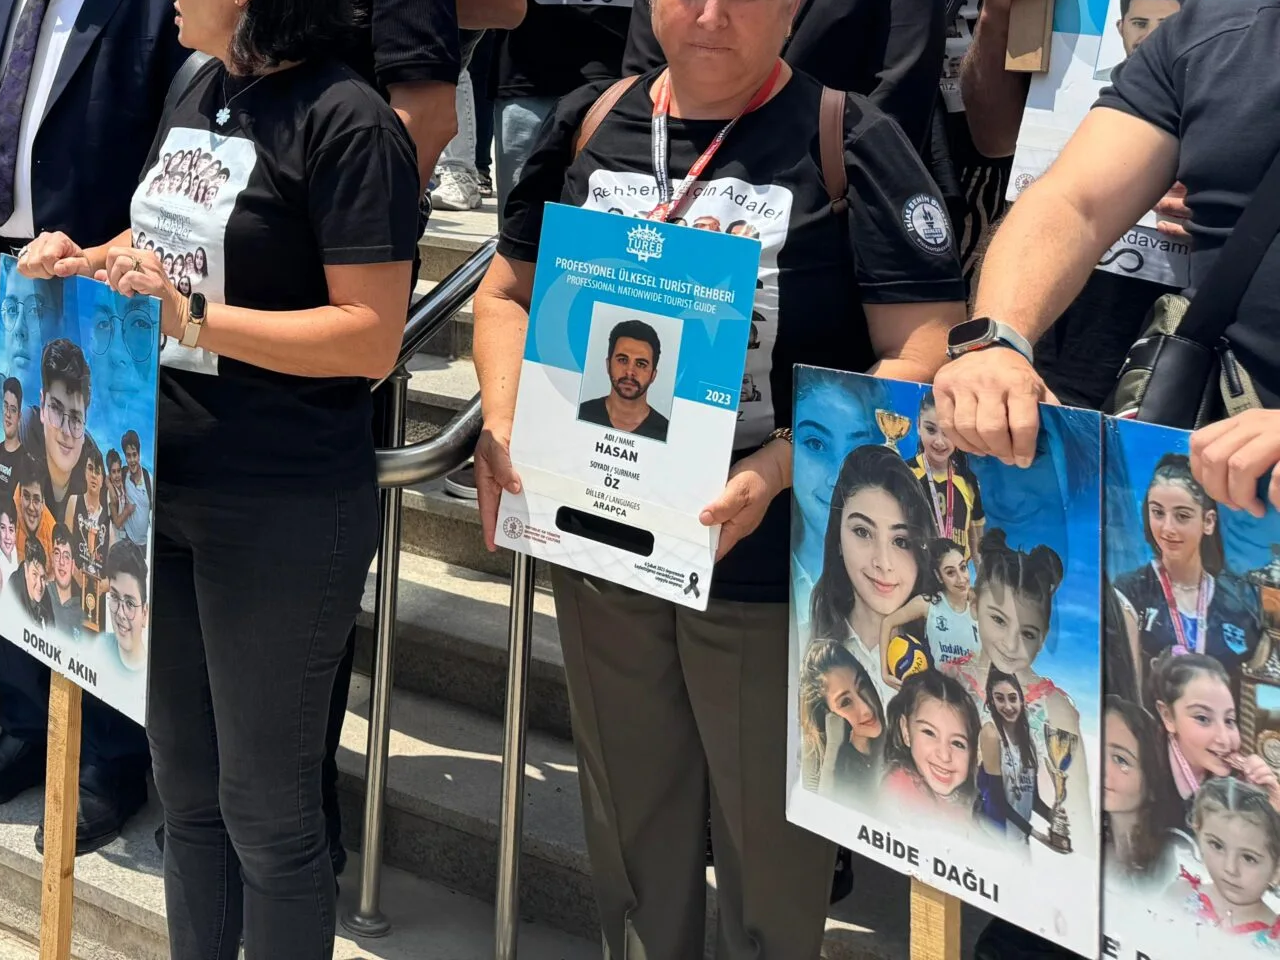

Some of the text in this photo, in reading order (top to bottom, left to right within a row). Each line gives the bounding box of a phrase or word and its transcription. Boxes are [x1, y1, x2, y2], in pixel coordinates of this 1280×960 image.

[720, 185, 784, 221] Adalet
[628, 238, 663, 253] TUREB
[555, 257, 735, 303] PROFESYONEL ÜLKESEL TURİST REHBERİ
[566, 275, 716, 314] PROFESSIONAL NATIONWIDE TOURIST GUIDE
[705, 389, 732, 406] 2023
[604, 433, 615, 443] ADI
[618, 437, 635, 447] NAME
[595, 442, 639, 463] HASAN
[589, 460, 610, 472] SOYADI
[613, 466, 640, 481] SURNAME
[604, 473, 620, 490] ÖZ
[585, 487, 605, 500] DİLLER
[609, 495, 641, 511] LANGUAGES
[593, 500, 627, 518] ARAPÇA
[23, 628, 98, 687] DORUK AKIN
[857, 824, 1000, 904] ABİDE DAĞLI
